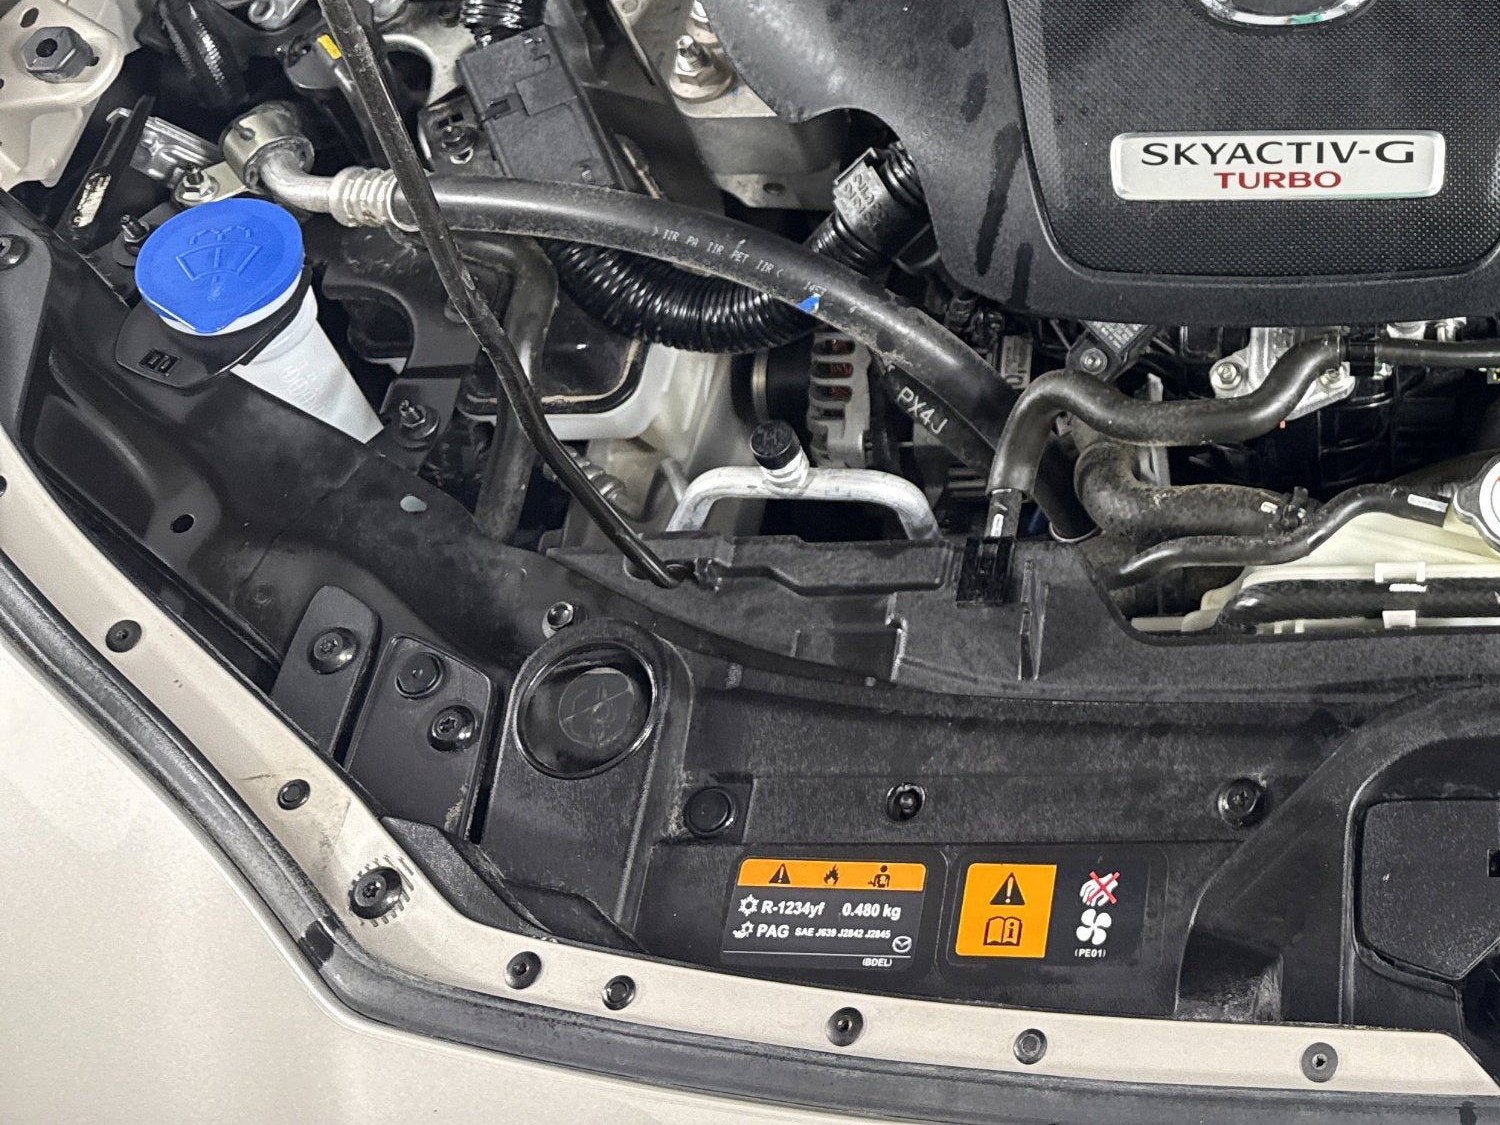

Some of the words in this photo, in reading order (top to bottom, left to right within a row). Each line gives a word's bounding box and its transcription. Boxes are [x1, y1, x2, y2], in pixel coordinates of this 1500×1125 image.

[1141, 140, 1415, 166] SKYACTIV-G
[1213, 170, 1342, 190] TURBO
[686, 234, 700, 249] PA
[706, 241, 725, 256] IIR
[729, 249, 750, 265] PET
[896, 385, 949, 436] PX4J
[760, 899, 826, 919] R-1234yf
[841, 902, 881, 918] 0.480
[882, 903, 902, 922] kg
[756, 923, 790, 939] PAG
[794, 927, 815, 937] SAE
[815, 927, 837, 938] J639
[837, 928, 865, 938] J2842
[861, 957, 893, 968] (BDEL)
[1073, 947, 1107, 959] (PE01)
